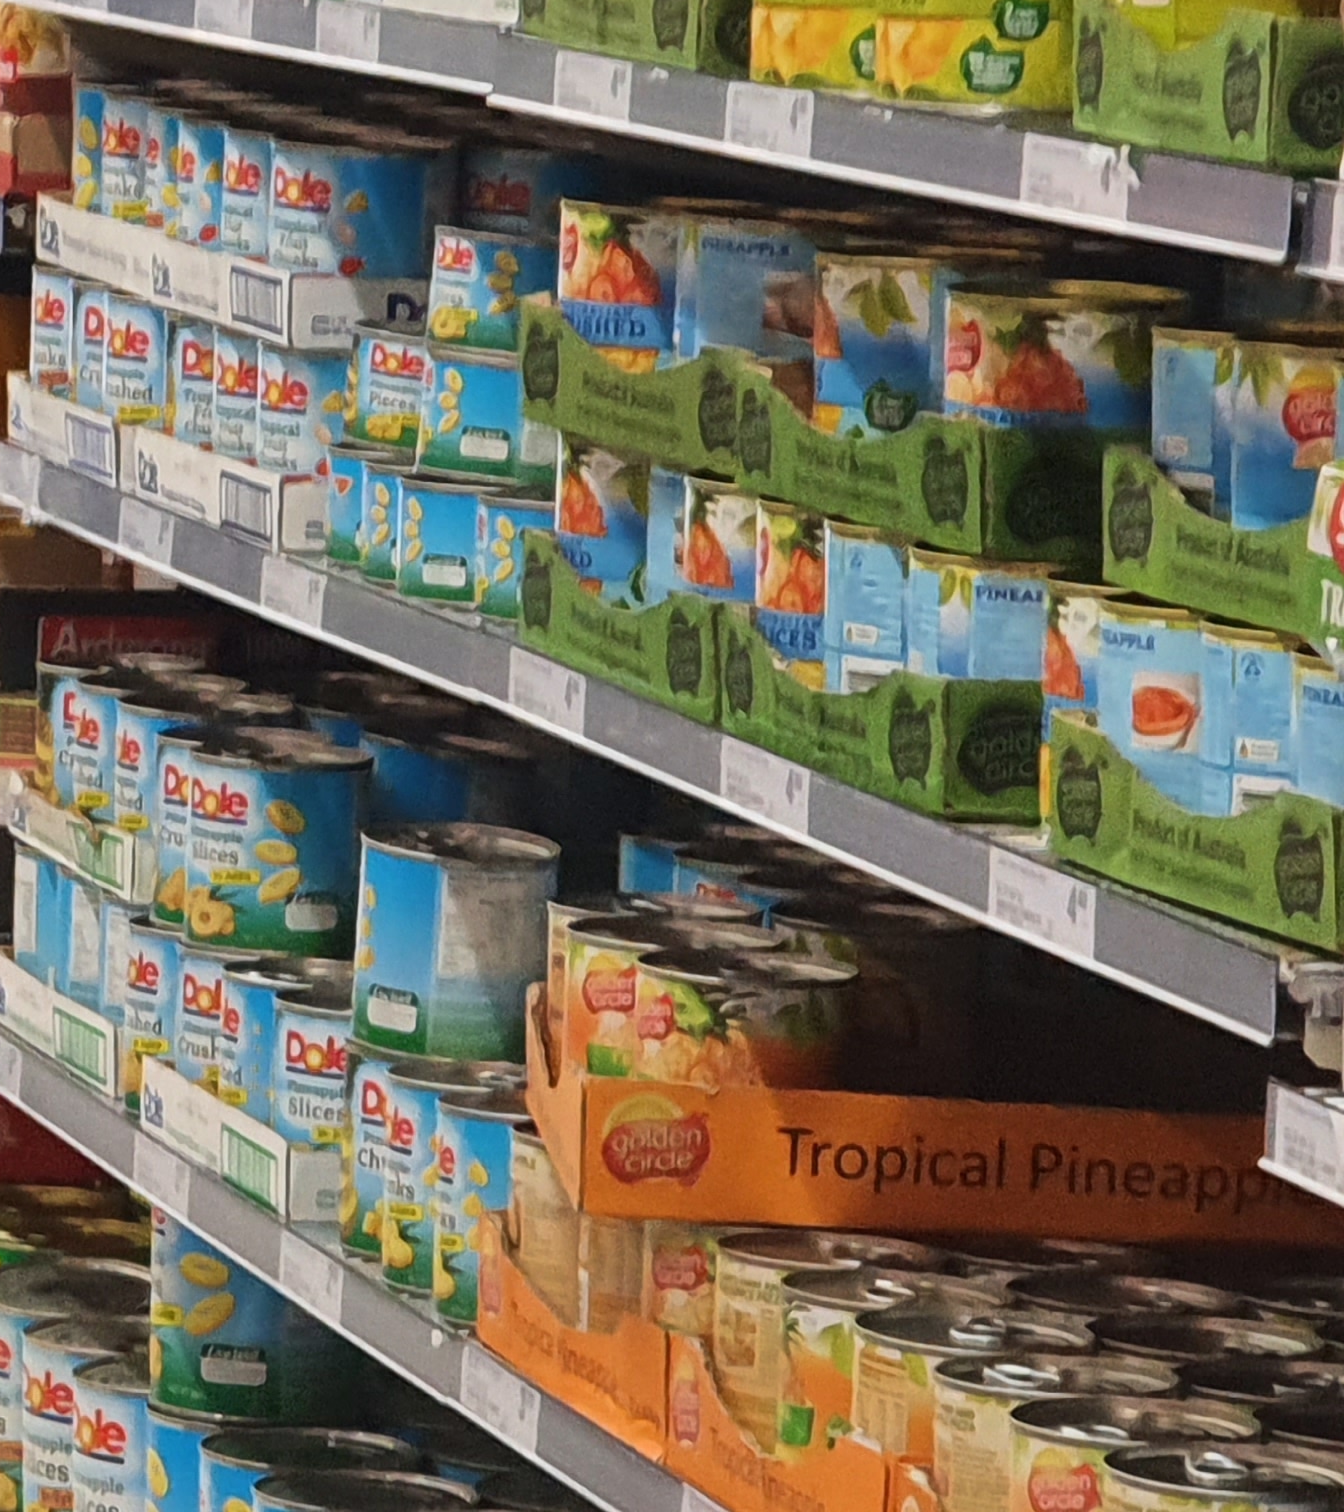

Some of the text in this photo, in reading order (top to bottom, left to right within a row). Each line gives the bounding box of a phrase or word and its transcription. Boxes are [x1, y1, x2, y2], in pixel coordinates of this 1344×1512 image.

[104, 116, 141, 157] ole
[370, 342, 425, 380] Dole
[107, 380, 154, 403] shed
[262, 370, 310, 414] ole
[191, 775, 249, 820] Dole
[183, 973, 222, 1016] Dol
[178, 1035, 221, 1060] Crush
[285, 1029, 347, 1075] Dole
[612, 1124, 702, 1159] golden
[624, 1148, 695, 1174] circle
[777, 1125, 1007, 1196] Tropical
[24, 1370, 74, 1418] ole
[75, 1408, 127, 1456] ole
